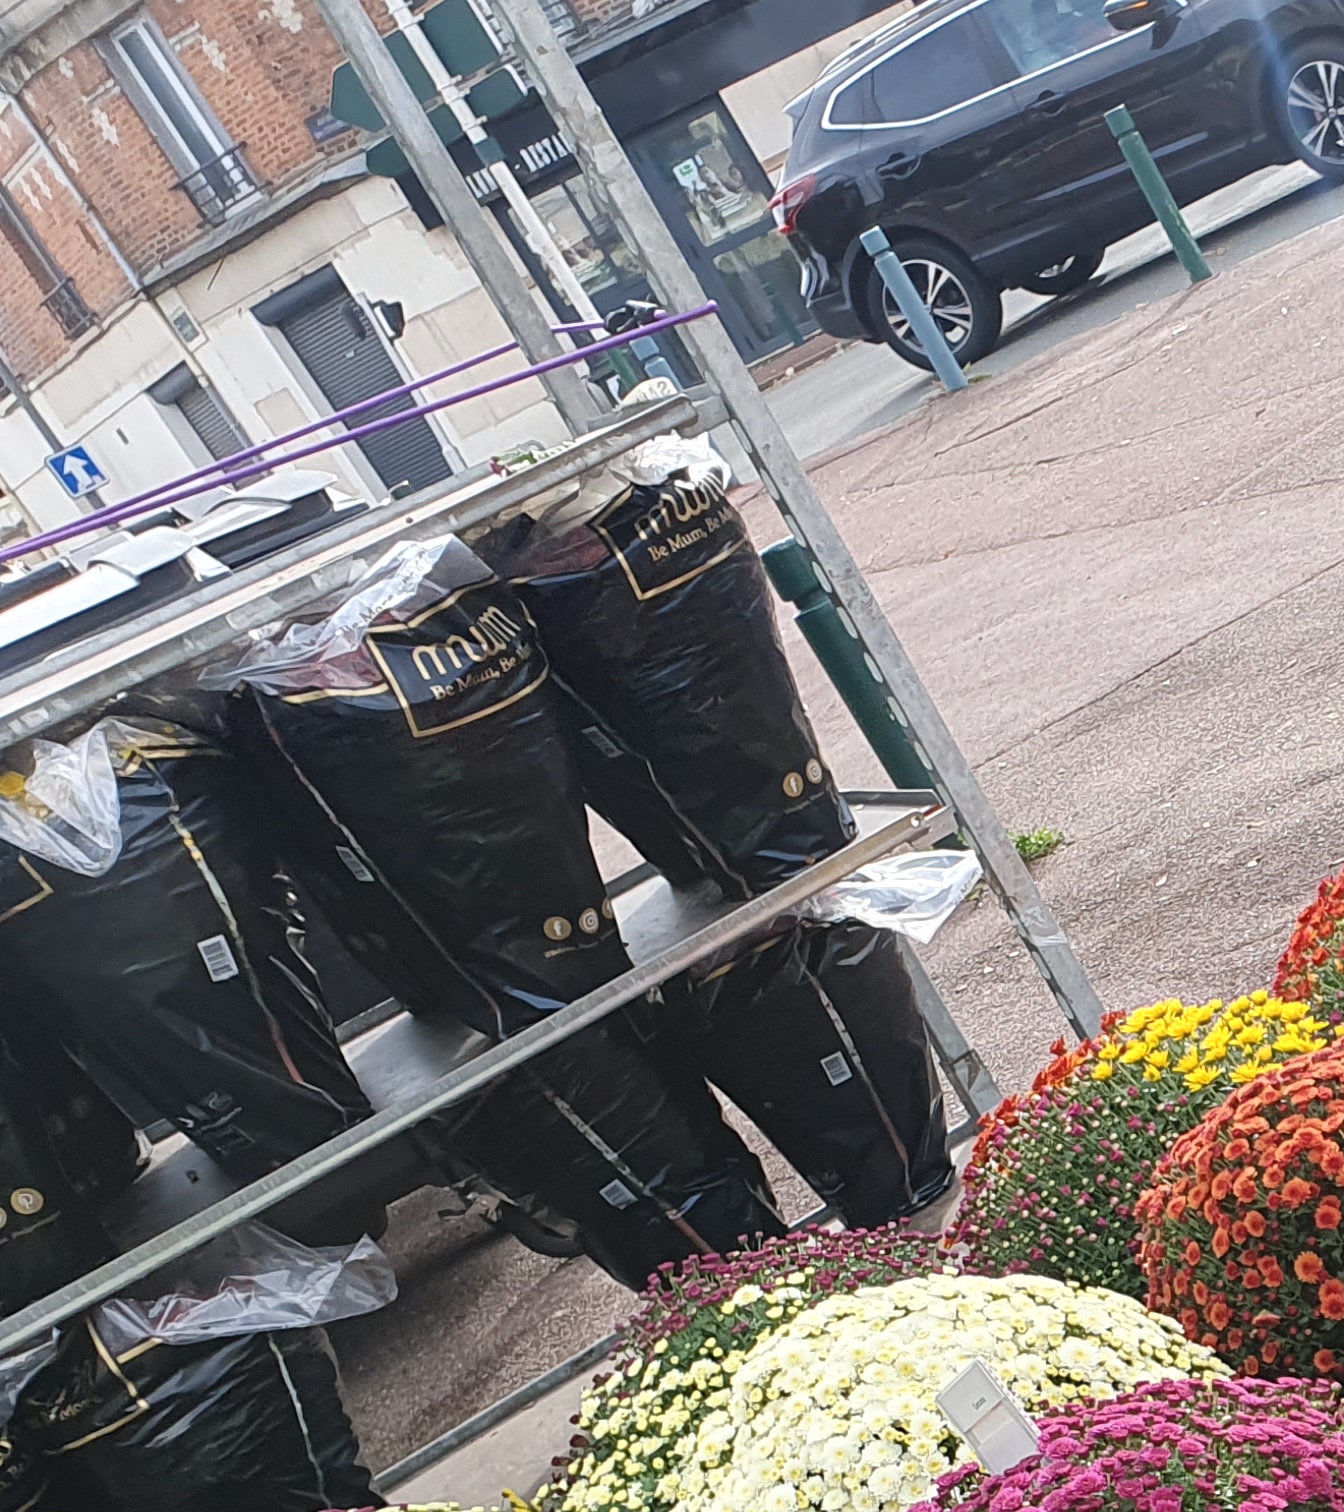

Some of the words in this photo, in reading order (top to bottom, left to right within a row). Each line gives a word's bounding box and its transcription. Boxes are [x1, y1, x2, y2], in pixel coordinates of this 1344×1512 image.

[648, 544, 669, 562] Be
[666, 528, 708, 553] Mum,
[704, 515, 720, 533] Be
[429, 684, 455, 700] Be
[499, 657, 516, 672] Be
